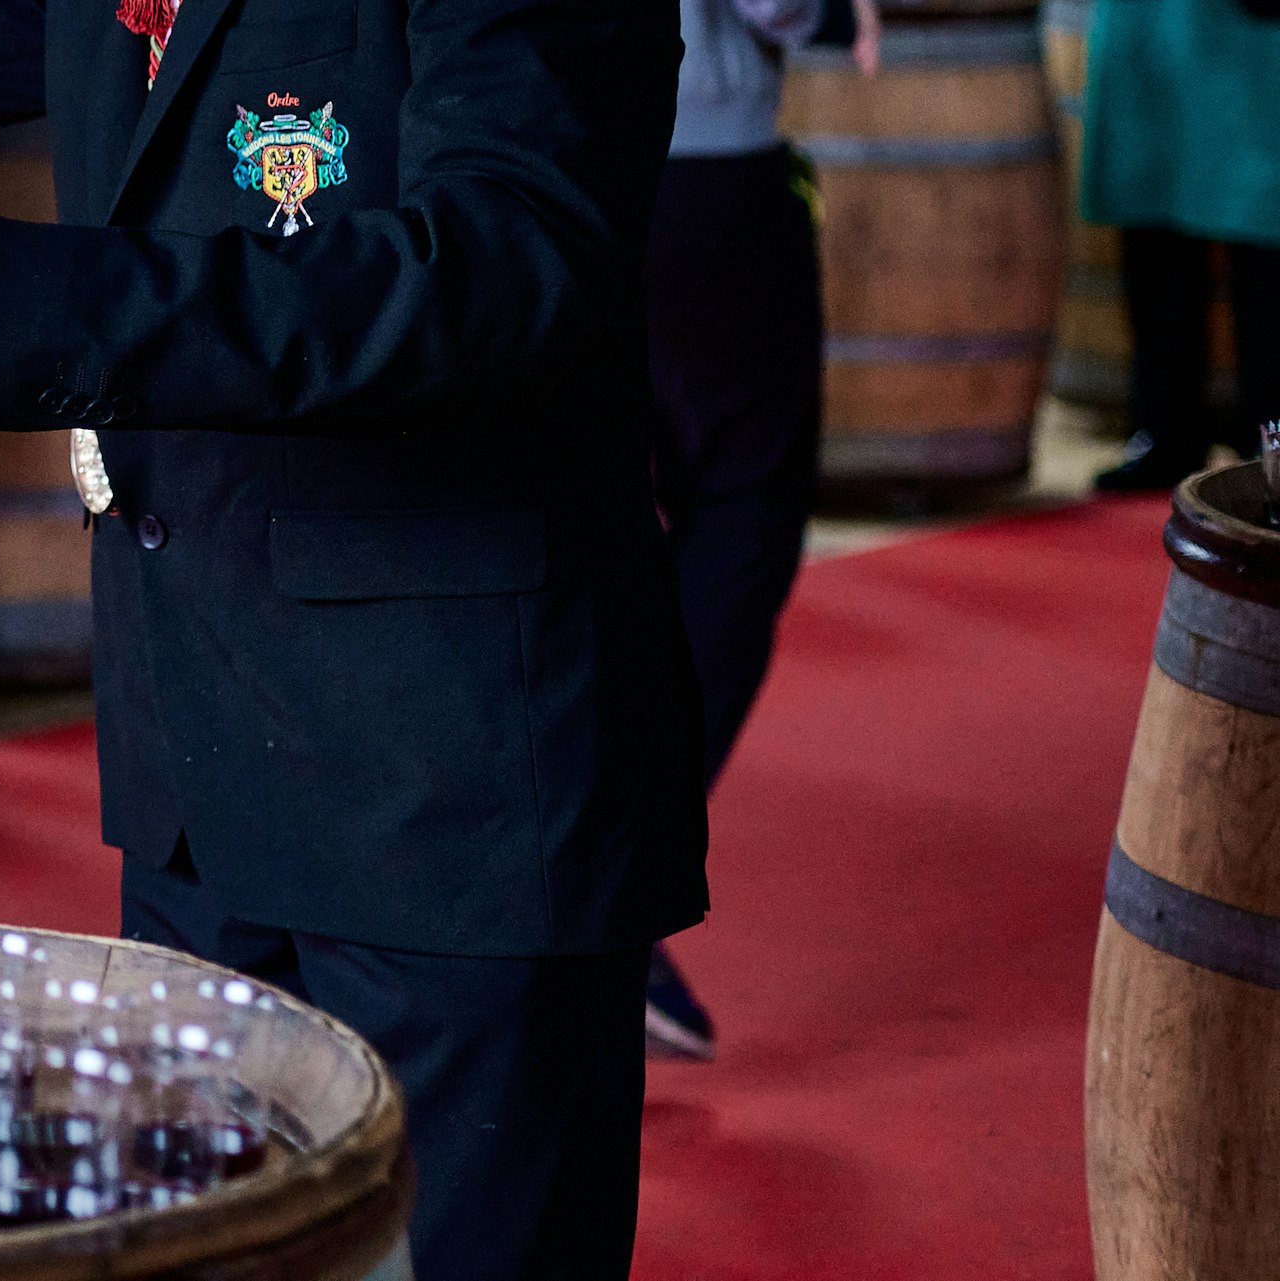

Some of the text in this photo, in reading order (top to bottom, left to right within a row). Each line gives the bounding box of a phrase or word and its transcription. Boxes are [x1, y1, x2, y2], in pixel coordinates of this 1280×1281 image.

[267, 91, 300, 108] Ordre
[275, 133, 290, 144] LES
[291, 132, 337, 157] TONNEAUX
